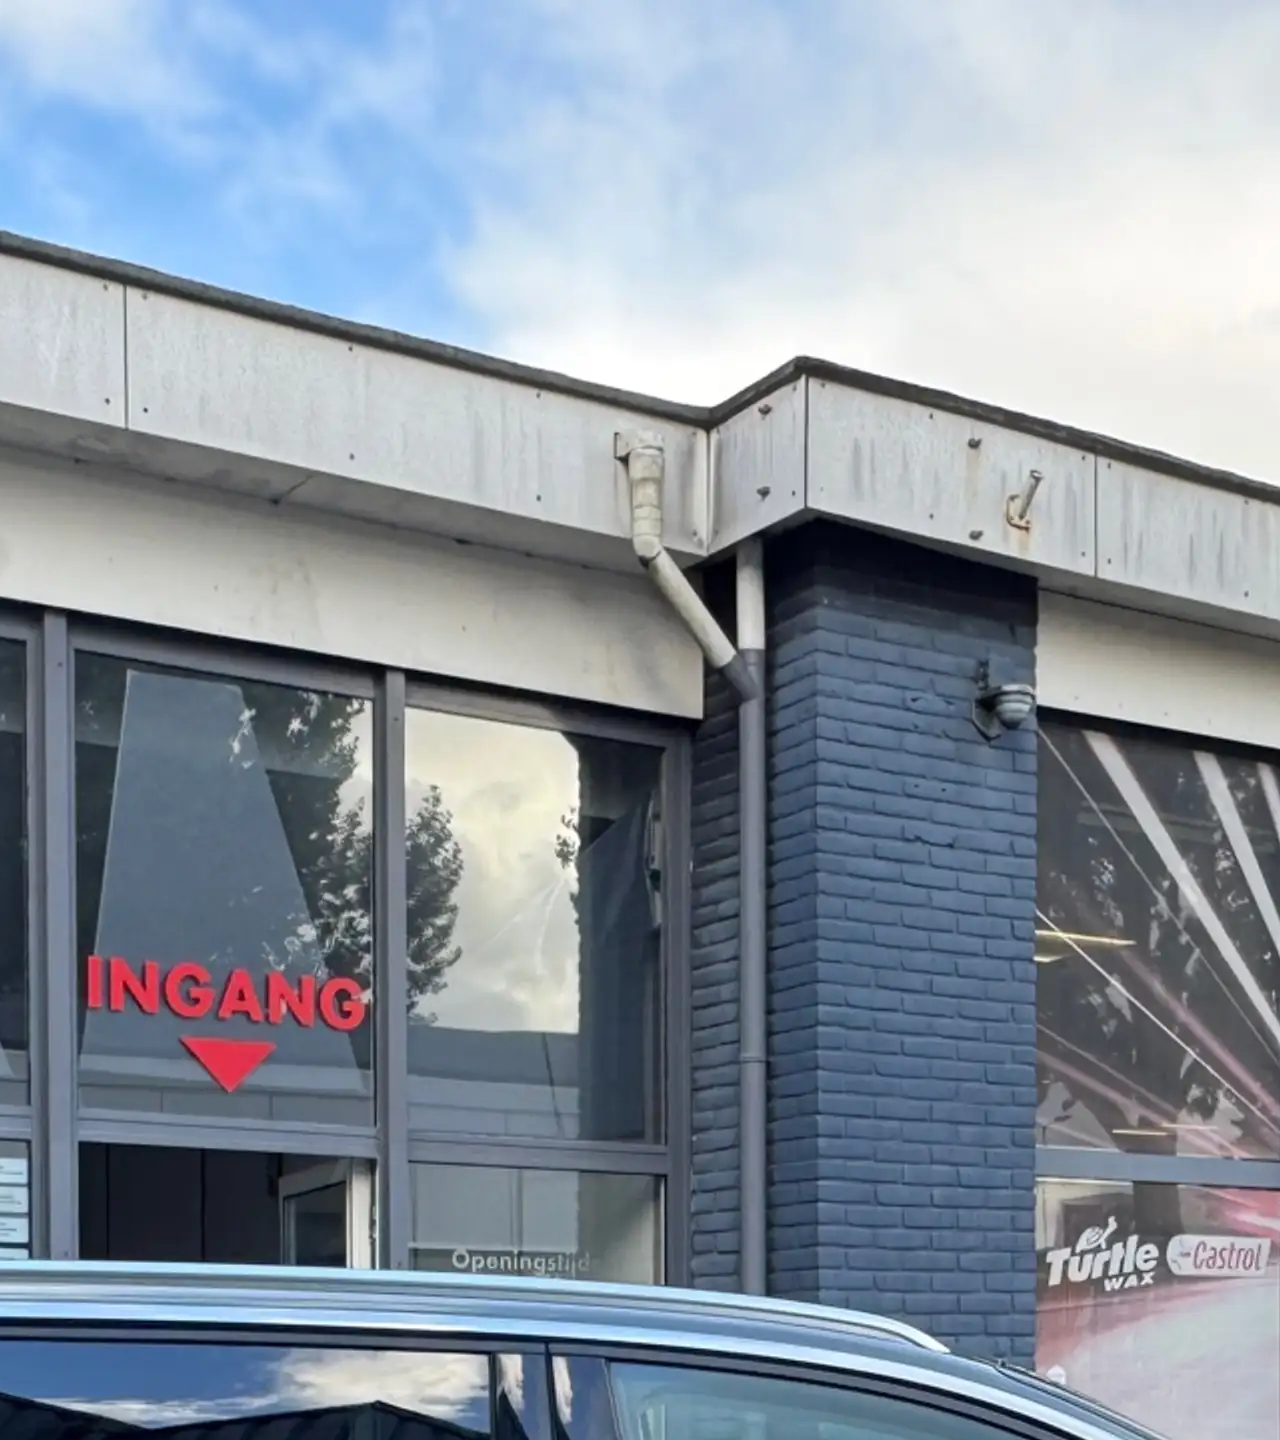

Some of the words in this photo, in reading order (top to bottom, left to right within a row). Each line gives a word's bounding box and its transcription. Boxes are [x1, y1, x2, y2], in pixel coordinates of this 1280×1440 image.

[87, 954, 367, 1032] INGANG
[451, 1247, 604, 1279] Openingstijd
[1046, 1234, 1160, 1287] Turtle
[1193, 1240, 1262, 1271] Castrol
[1104, 1271, 1156, 1292] WAX
